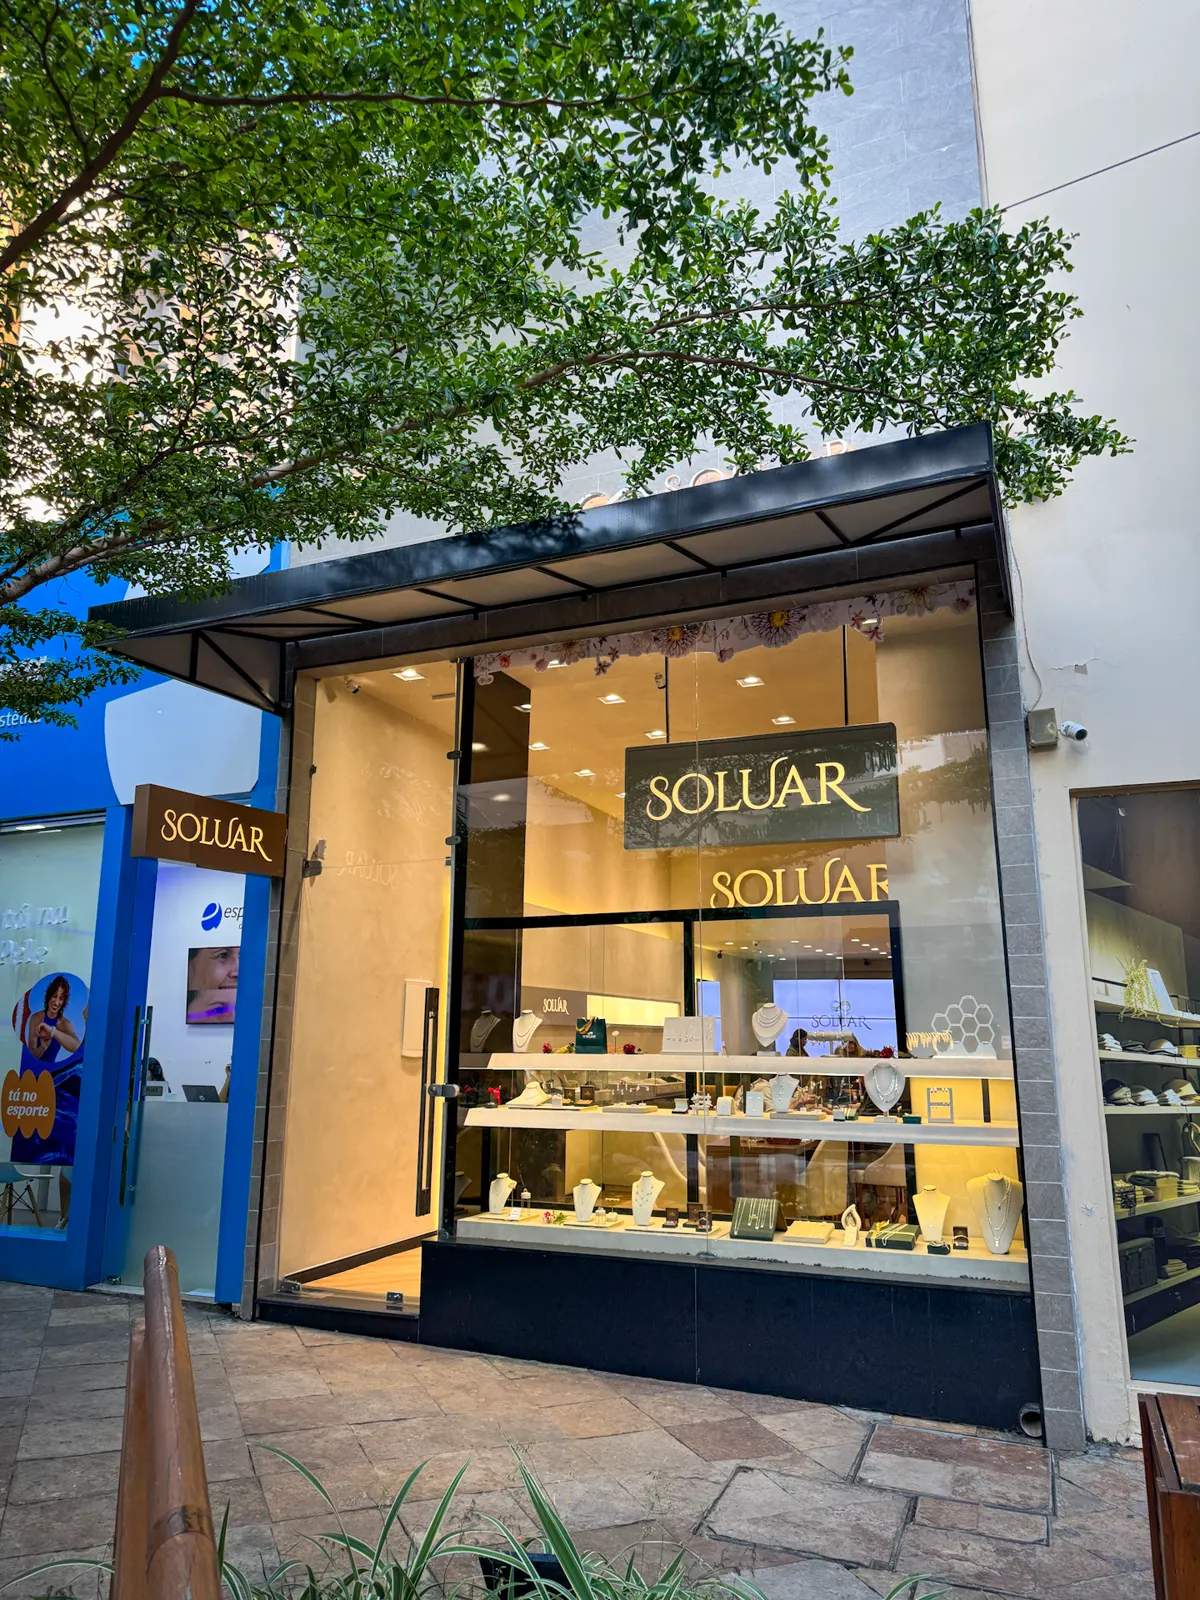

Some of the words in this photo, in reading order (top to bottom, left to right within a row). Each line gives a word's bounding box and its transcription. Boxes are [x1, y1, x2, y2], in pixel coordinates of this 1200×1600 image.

[646, 757, 872, 821] SOLUAR
[161, 809, 272, 862] SOLUAR
[8, 1087, 21, 1102] tá
[22, 1091, 38, 1102] no
[6, 1105, 50, 1120] esporte
